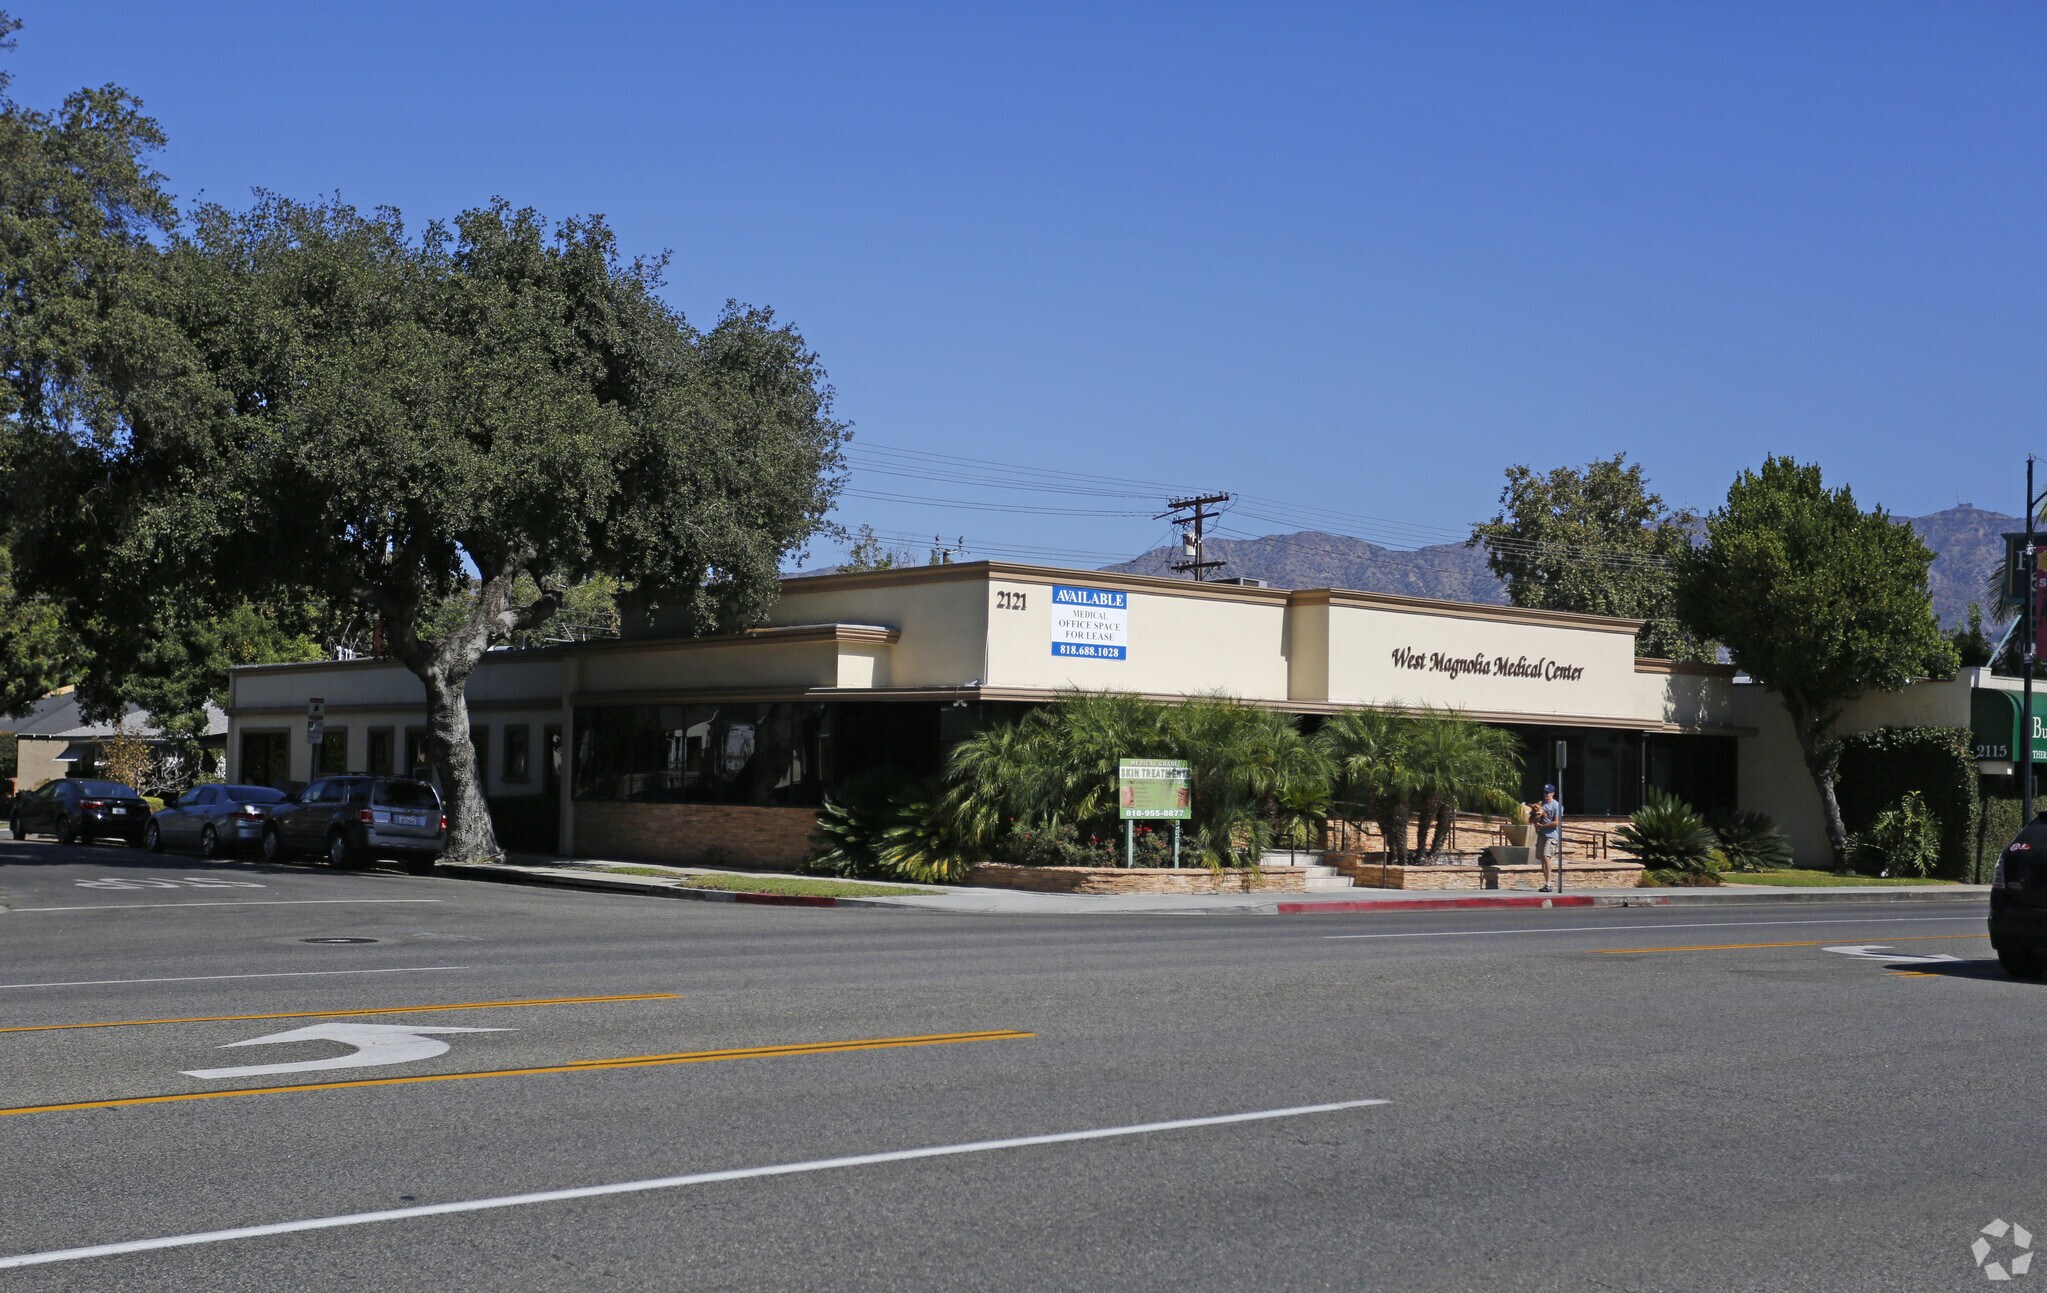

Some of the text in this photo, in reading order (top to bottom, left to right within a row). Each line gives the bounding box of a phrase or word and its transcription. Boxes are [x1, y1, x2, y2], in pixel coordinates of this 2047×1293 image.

[996, 590, 1027, 611] 2121
[1056, 589, 1124, 606] AVAILABLE
[1073, 609, 1108, 620] MEDICAL
[1058, 619, 1121, 632] OFFICE SPACE
[1065, 630, 1115, 642] FOR LEASE
[1060, 644, 1119, 657] 818.688.1028
[1391, 646, 1584, 682] West Magnolia Medical Center
[1976, 744, 2007, 758] 2115
[1120, 768, 1139, 778] SKIN
[1126, 809, 1184, 817] 818-955-8877
